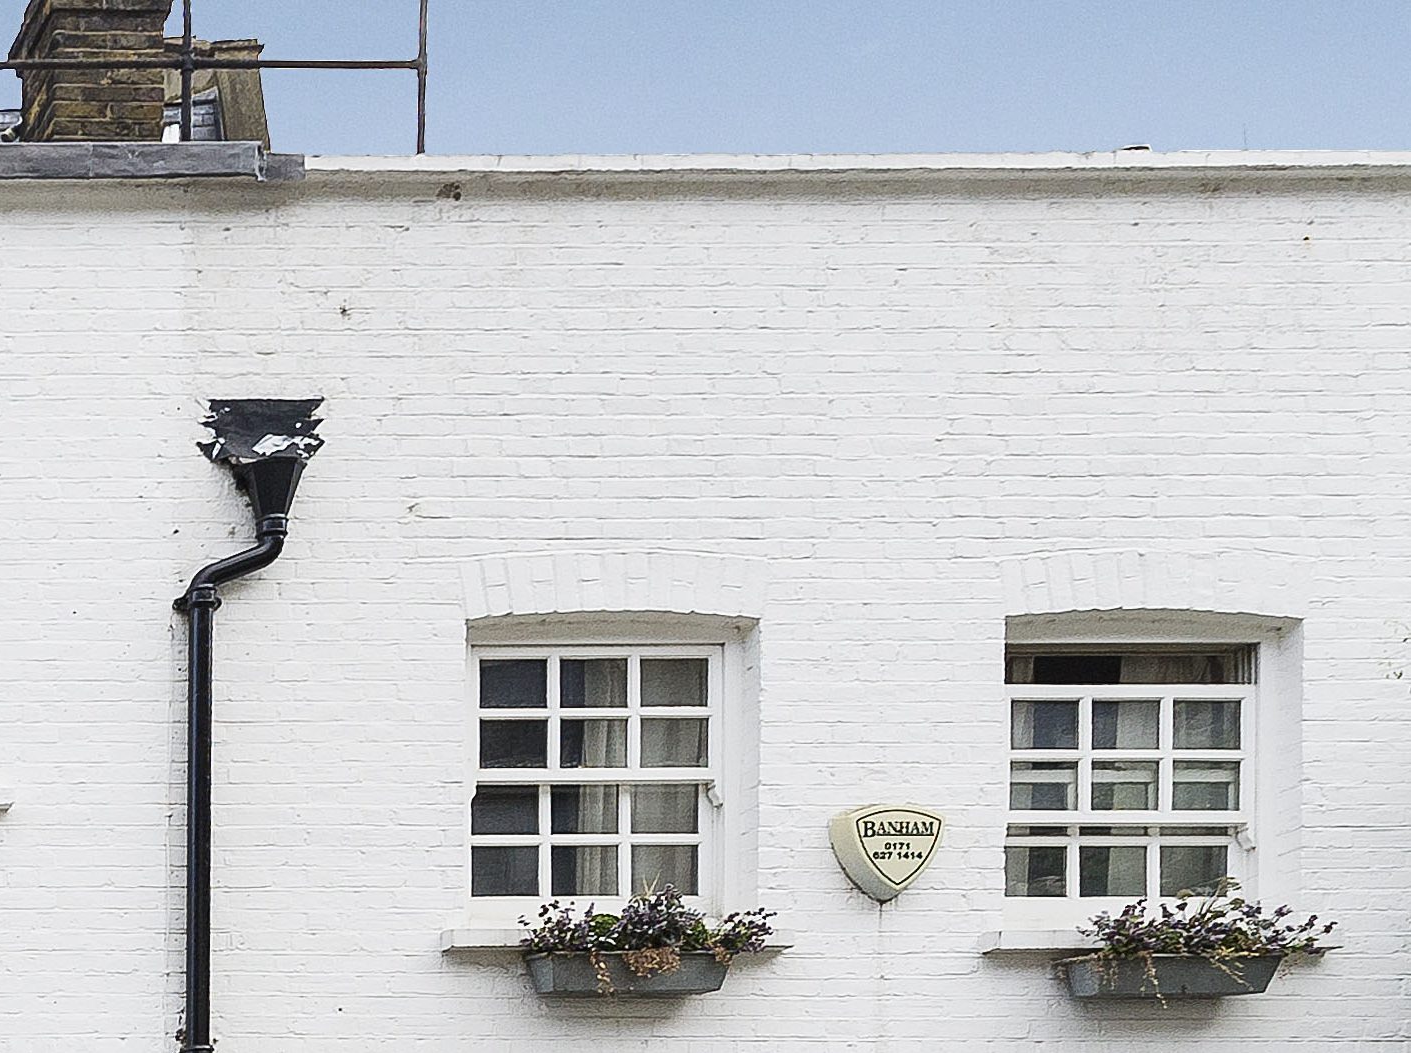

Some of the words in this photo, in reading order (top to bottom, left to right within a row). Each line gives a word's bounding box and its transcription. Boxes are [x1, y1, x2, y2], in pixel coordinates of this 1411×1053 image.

[862, 820, 934, 838] BANHAM
[884, 842, 911, 850] 0171
[872, 851, 893, 860] 627
[896, 851, 923, 860] 1414
